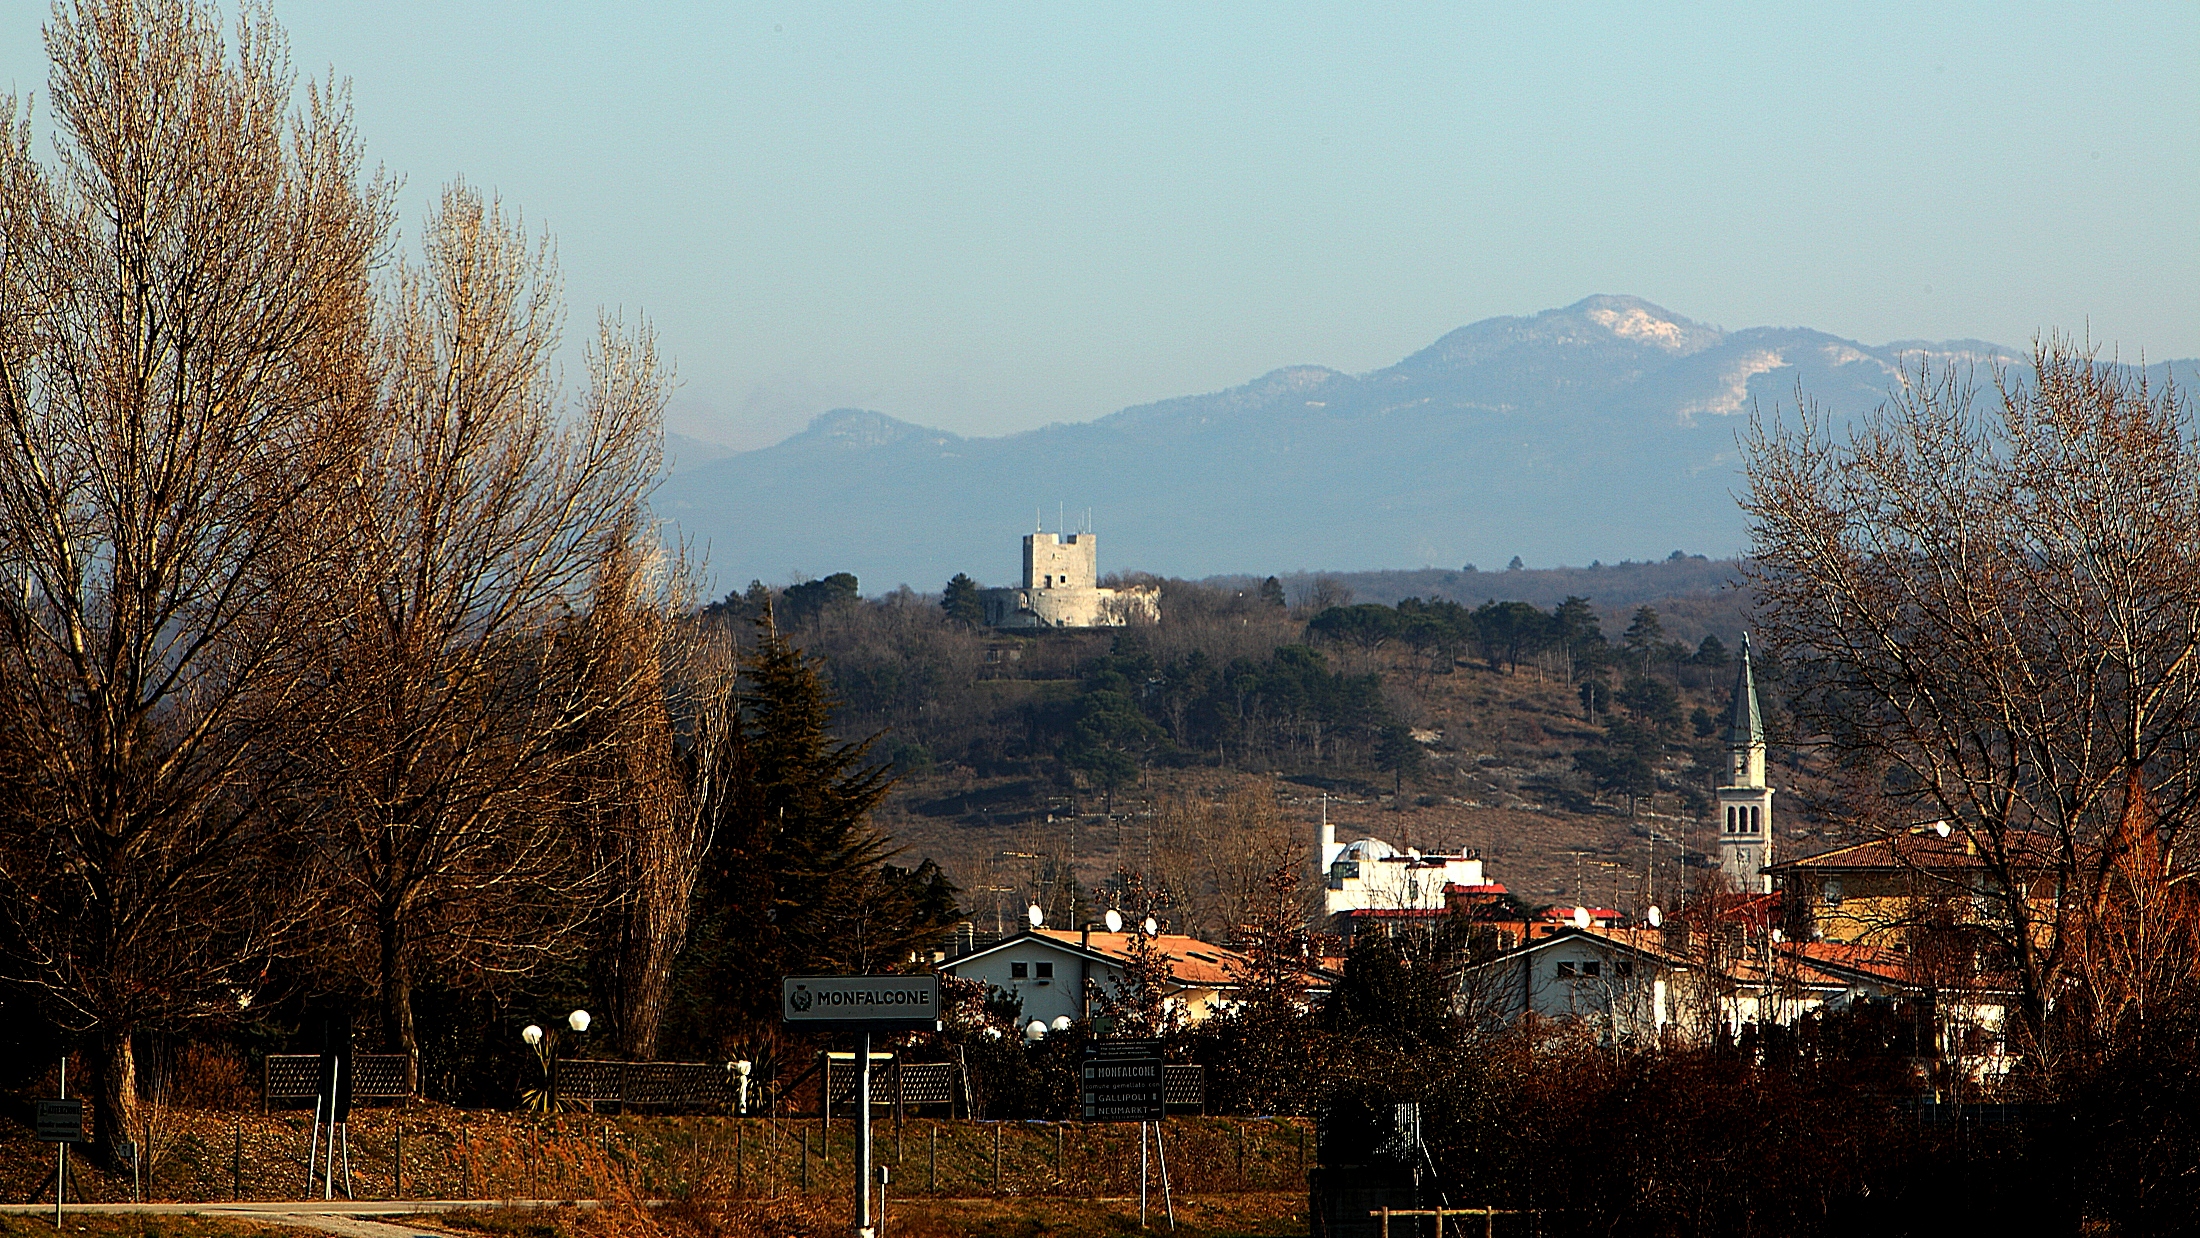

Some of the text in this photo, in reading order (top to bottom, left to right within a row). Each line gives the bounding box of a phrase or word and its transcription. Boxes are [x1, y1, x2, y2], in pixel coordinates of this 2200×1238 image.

[818, 990, 929, 1006] MONFALCONE
[1098, 1066, 1156, 1078] MONFALCONE
[1098, 1093, 1146, 1102] GALLIPOLI
[1098, 1106, 1148, 1115] NEUMARKT
